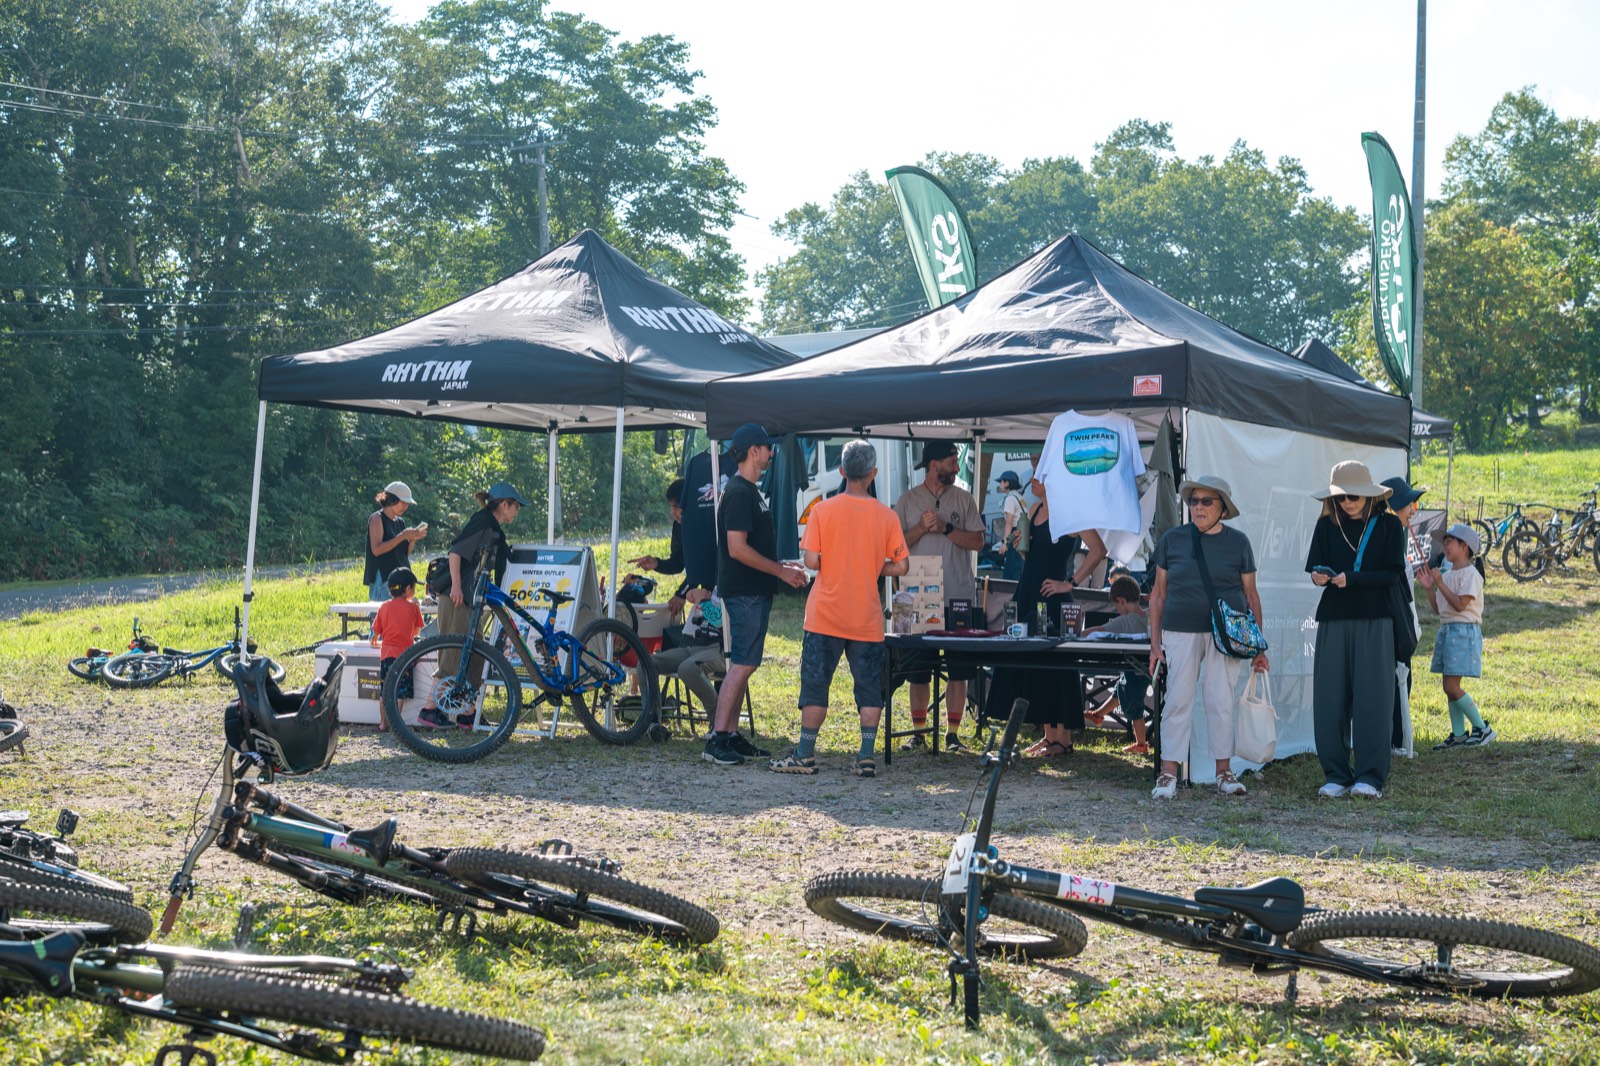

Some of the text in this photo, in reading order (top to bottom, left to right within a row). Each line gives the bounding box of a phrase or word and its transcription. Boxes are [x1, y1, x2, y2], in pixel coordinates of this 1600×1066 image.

[619, 306, 738, 334] RHYTHM
[719, 333, 751, 345] JAPAN
[381, 360, 473, 383] RHYTHM
[440, 381, 469, 391] JAPAN
[509, 589, 540, 602] 50%
